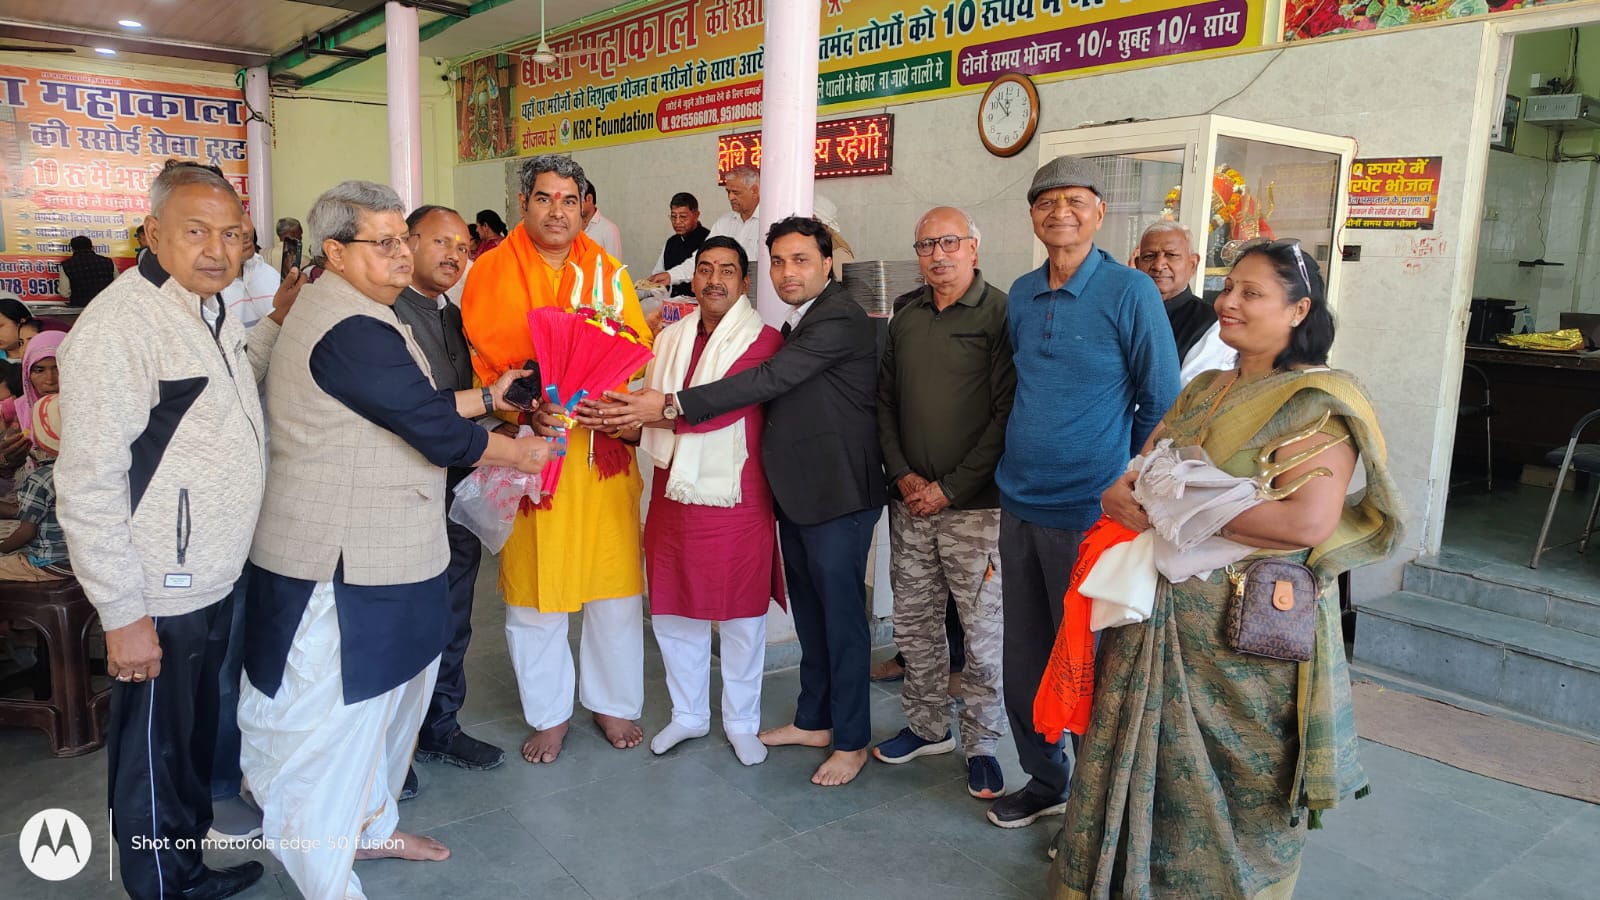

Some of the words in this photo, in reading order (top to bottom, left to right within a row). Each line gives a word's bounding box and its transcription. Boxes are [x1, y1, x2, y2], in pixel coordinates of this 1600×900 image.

[819, 26, 855, 60] तमंद
[858, 14, 904, 51] लोगों
[909, 8, 936, 41] को
[943, 0, 976, 35] 10
[962, 51, 987, 76] दोनों
[990, 49, 1021, 71] समय
[1023, 42, 1061, 67] भोजन
[1118, 26, 1152, 59] सुबह
[1203, 11, 1241, 38] सांय
[537, 101, 546, 116] पर
[548, 92, 571, 114] मरीजों
[573, 88, 585, 108] को
[587, 86, 618, 110] निशुल्क
[621, 77, 649, 100] भोजन
[651, 75, 659, 93] व
[661, 62, 693, 91] मरीजों
[697, 60, 708, 84] के
[711, 58, 736, 81] साथ
[855, 71, 875, 94] बेकार
[880, 71, 889, 89] ना
[891, 63, 909, 88] जाये
[911, 58, 934, 84] नाली
[39, 80, 244, 125] महाकाल
[30, 118, 70, 147] की
[77, 123, 141, 155] रसोई
[149, 127, 199, 157] सेवा
[573, 119, 592, 140] KRC
[596, 109, 654, 137] Foundation
[837, 122, 882, 166] रहेगी
[32, 158, 58, 186] 10
[1385, 176, 1435, 193] भोजन
[1409, 158, 1430, 175] में
